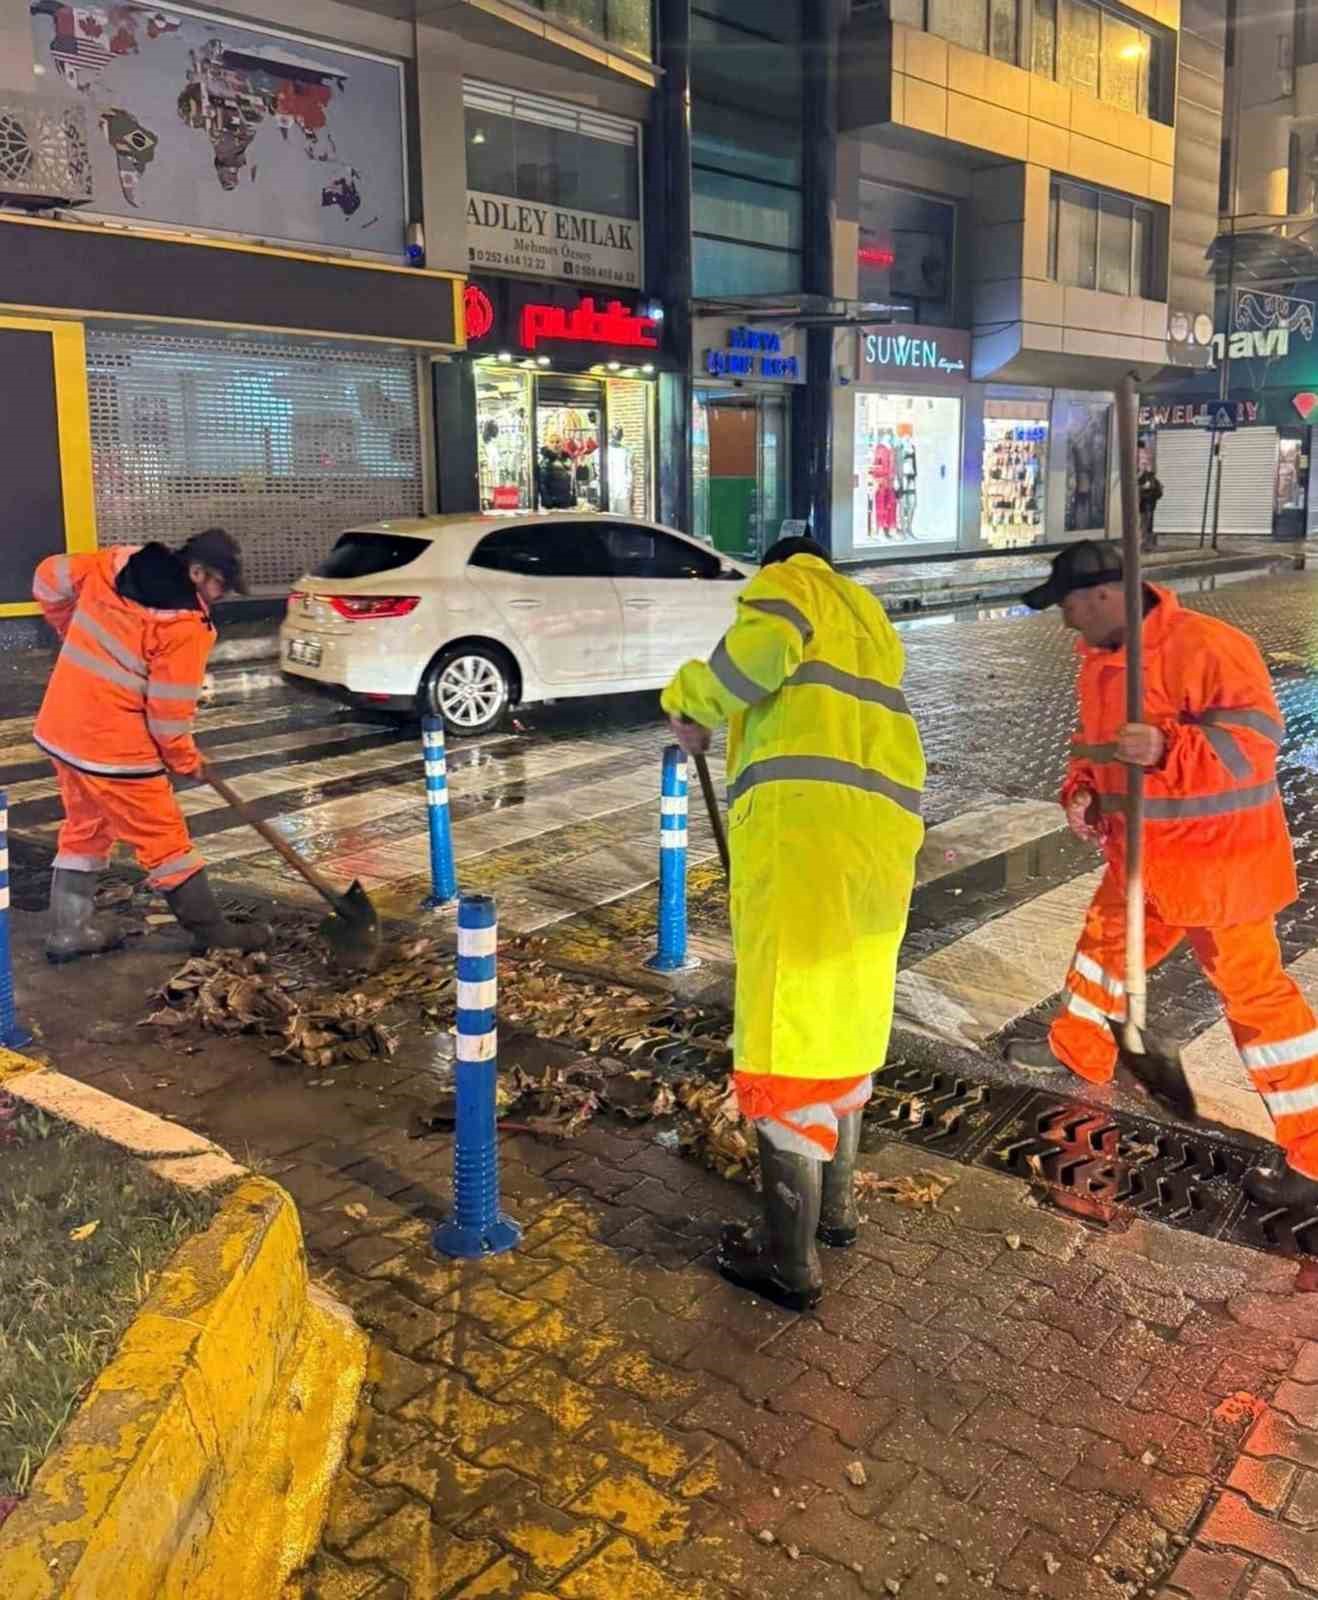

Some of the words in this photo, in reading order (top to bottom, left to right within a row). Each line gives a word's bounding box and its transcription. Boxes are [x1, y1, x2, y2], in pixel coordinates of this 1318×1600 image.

[466, 197, 548, 236] ADLEY
[555, 212, 633, 250] EMLAK
[521, 297, 657, 349] public
[865, 335, 936, 368] SUWEN
